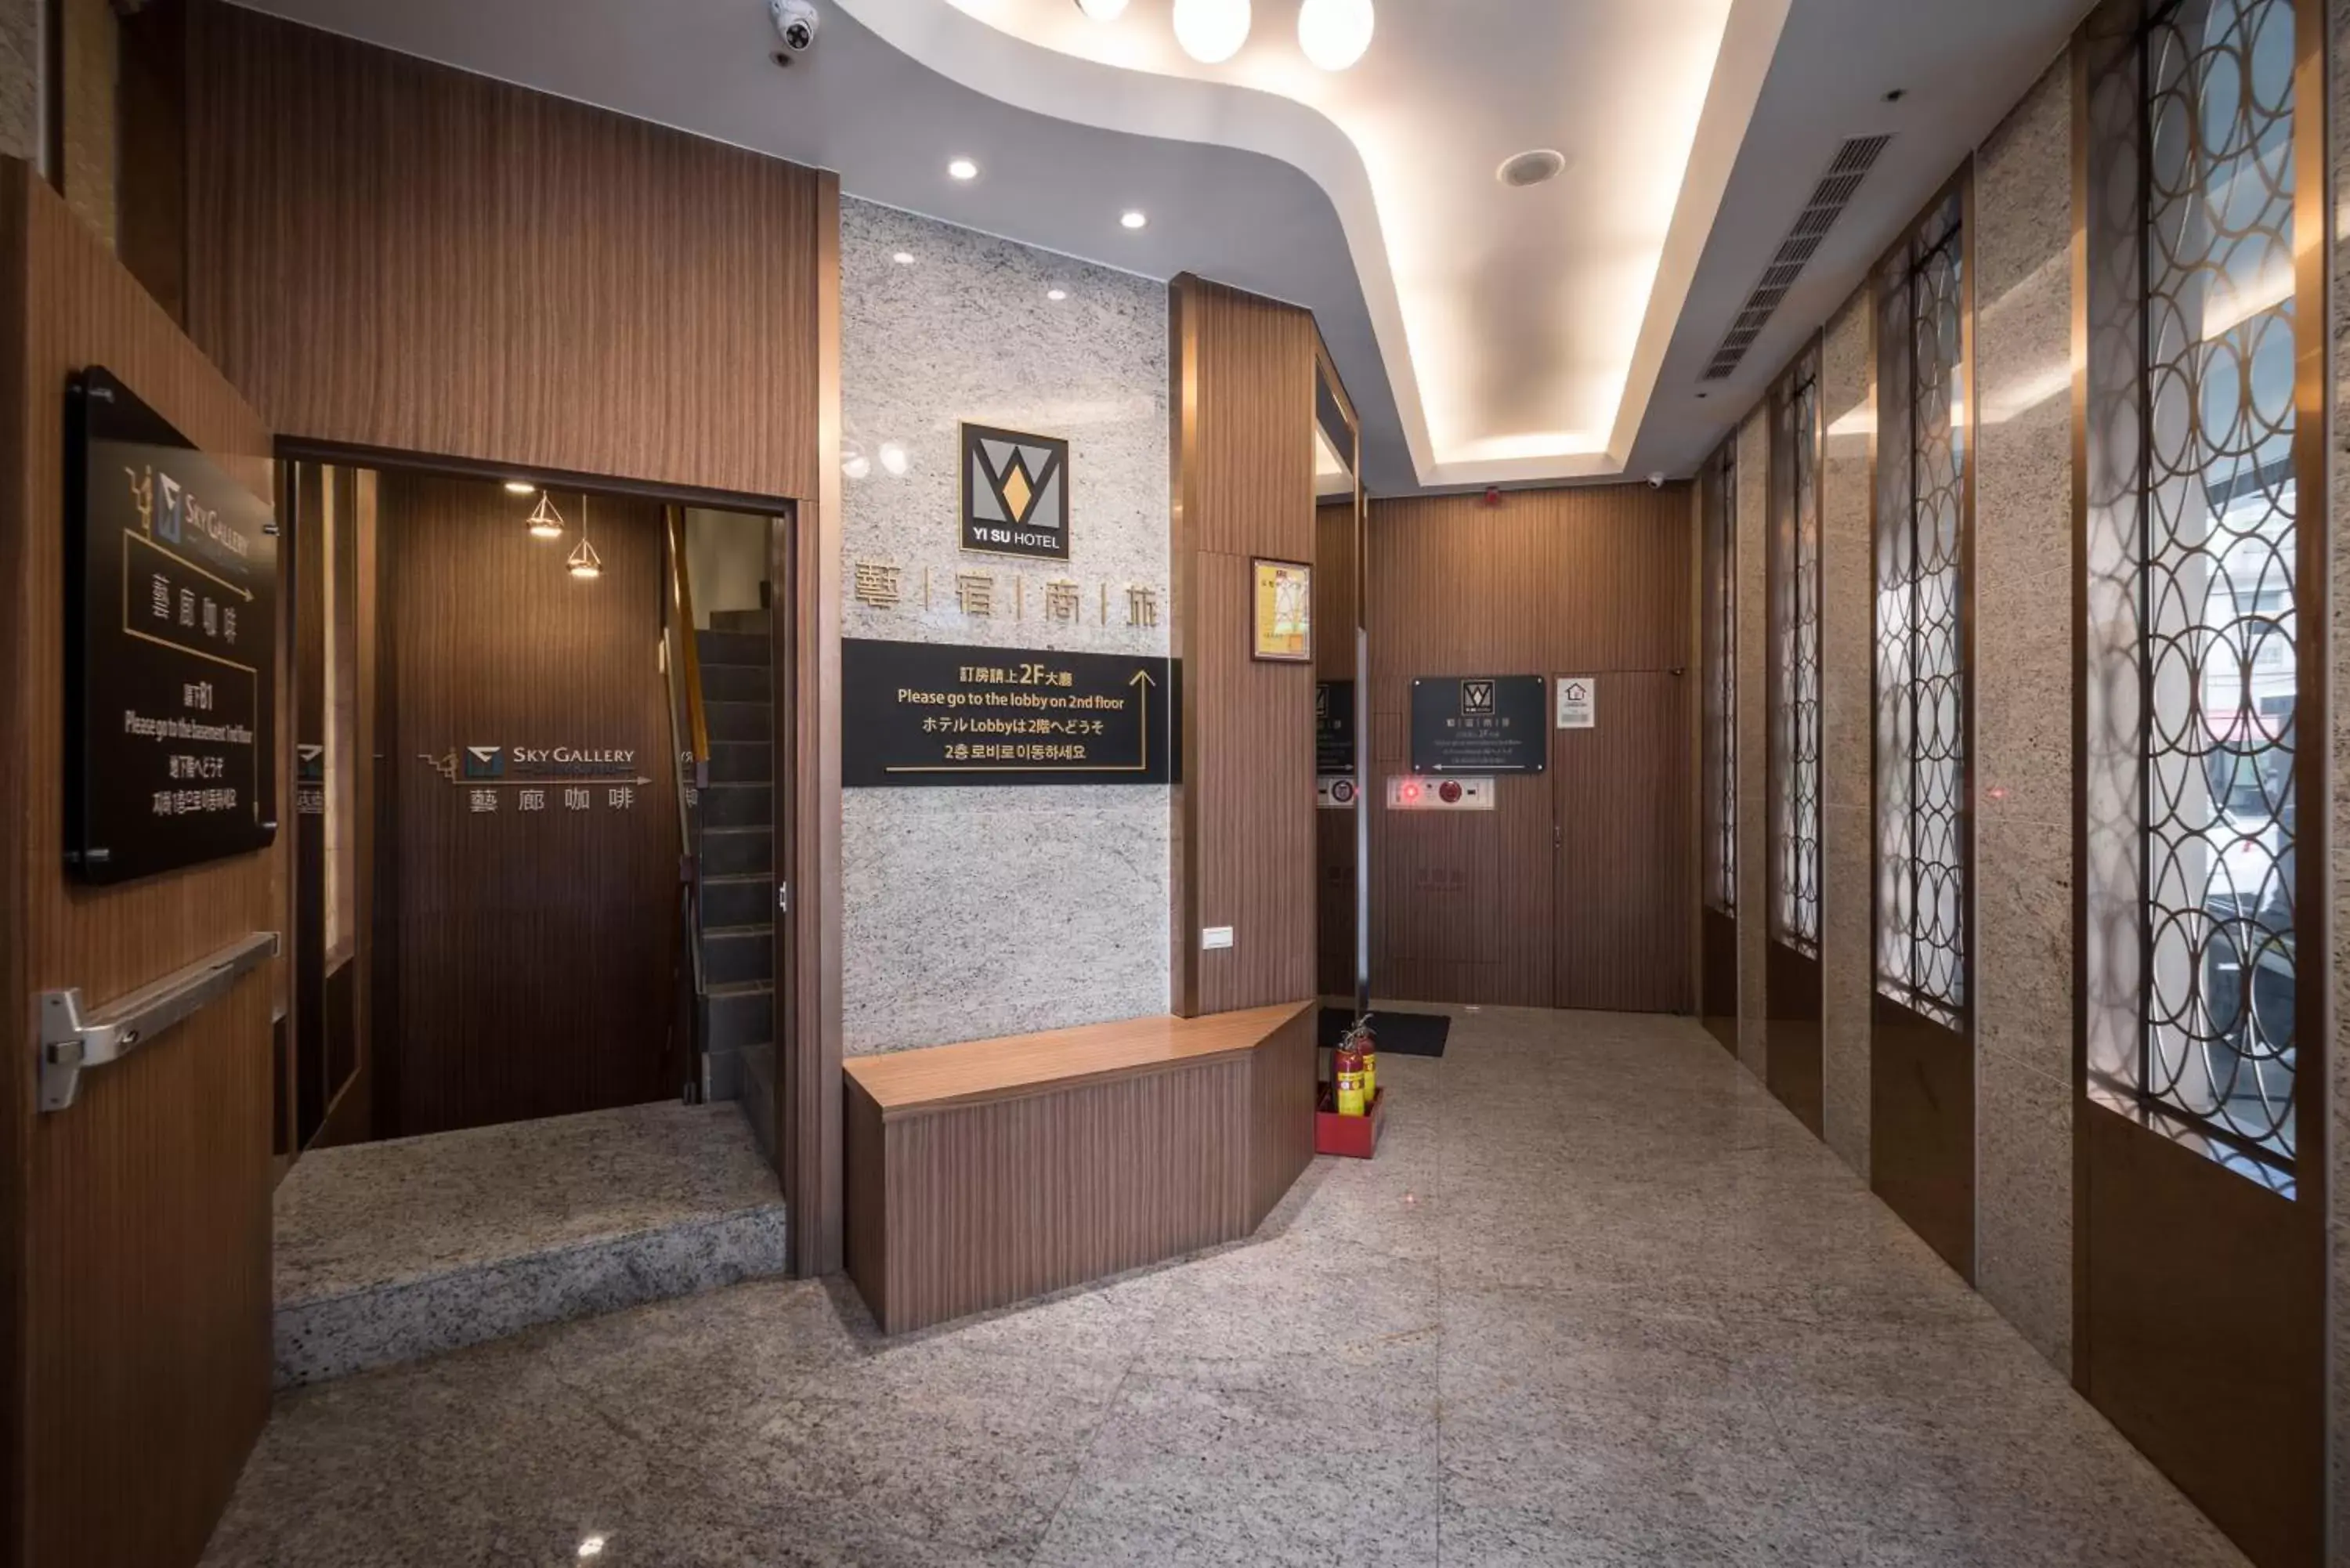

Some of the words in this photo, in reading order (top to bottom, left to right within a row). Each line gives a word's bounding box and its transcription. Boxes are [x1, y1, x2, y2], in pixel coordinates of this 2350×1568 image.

[973, 526, 987, 541] YI
[990, 528, 1010, 543] SU
[1014, 532, 1060, 549] HOTEL
[898, 688, 945, 703] Please
[948, 692, 966, 706] go
[968, 692, 983, 705] to
[985, 690, 1008, 706] the
[1010, 692, 1050, 710] lobby
[1050, 696, 1066, 708] on
[1068, 695, 1093, 709] 2nd
[1095, 695, 1125, 710] floor
[125, 710, 155, 735] Please
[513, 746, 549, 763] SKY
[553, 746, 634, 763] GALLERY
[945, 743, 969, 761] 2층
[470, 786, 634, 813] 藝廊咖啡
